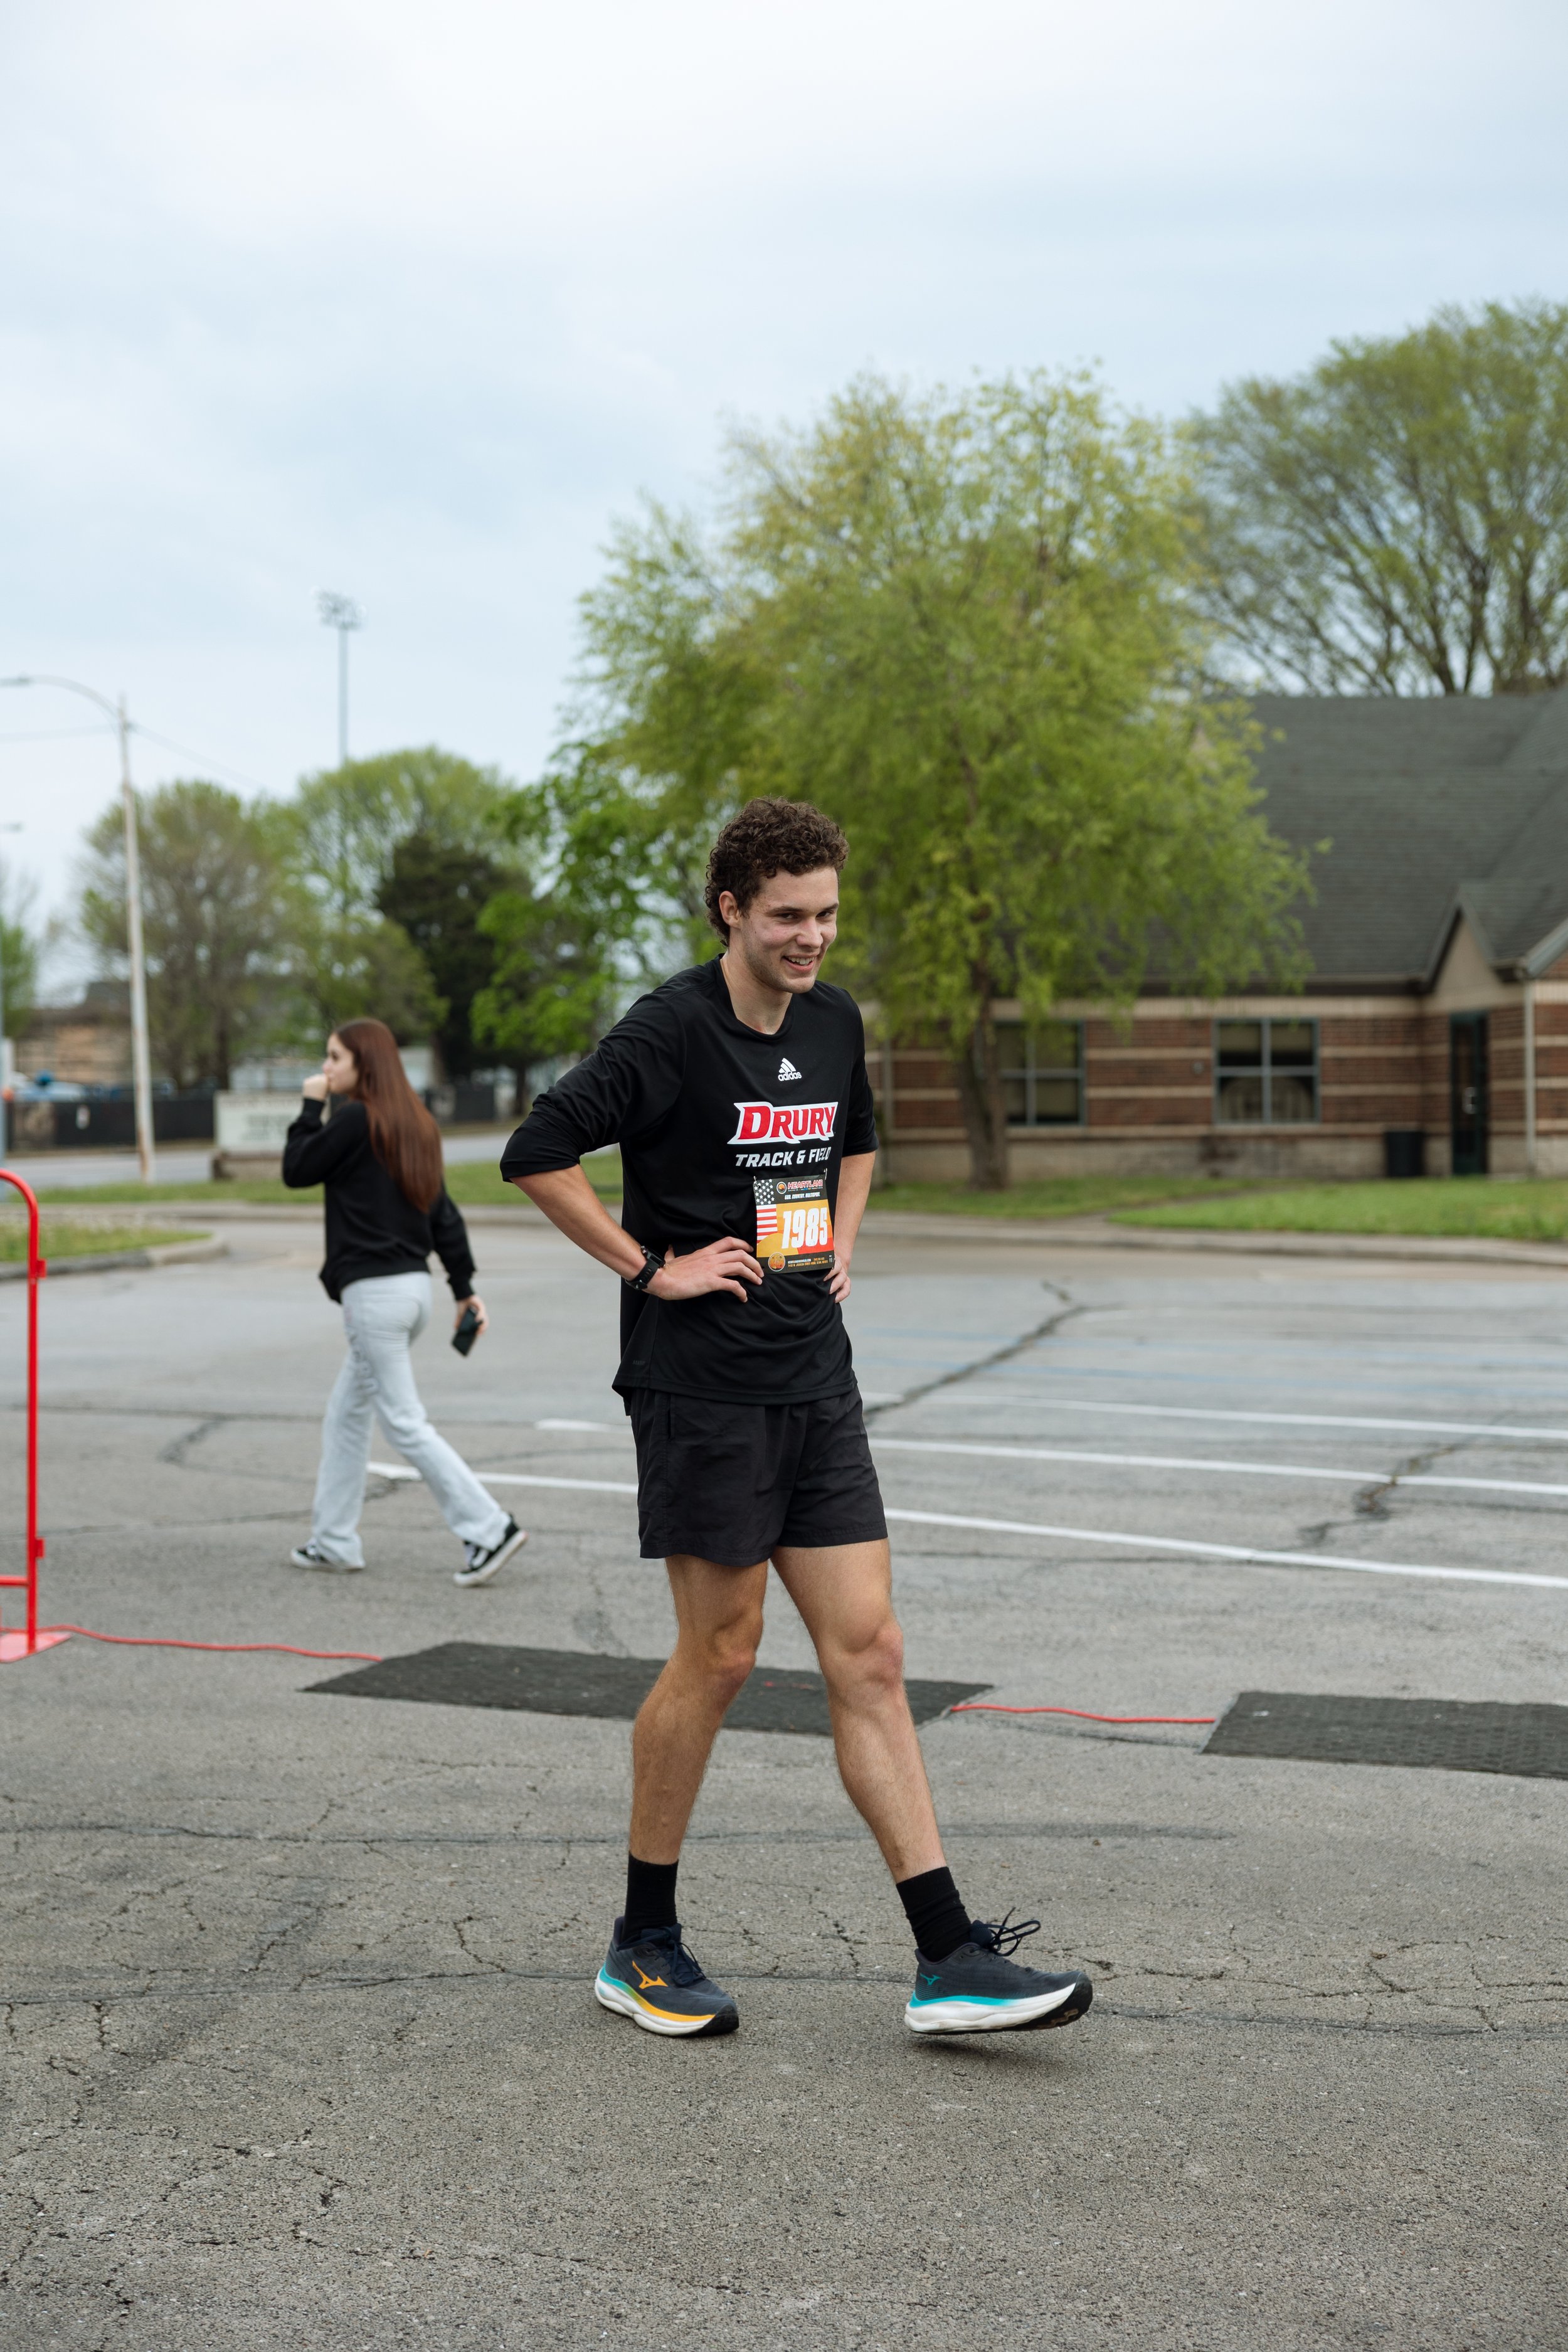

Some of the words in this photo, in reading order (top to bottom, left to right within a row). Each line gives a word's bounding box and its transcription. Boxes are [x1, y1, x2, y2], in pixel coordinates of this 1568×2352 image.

[778, 1071, 802, 1081] adidas
[738, 1106, 835, 1140] DRURY
[735, 1152, 794, 1167] TRACK
[797, 1150, 806, 1165] &
[808, 1147, 832, 1162] FIELD
[787, 1179, 823, 1189] HEARTLAND
[781, 1207, 827, 1249] 1985
